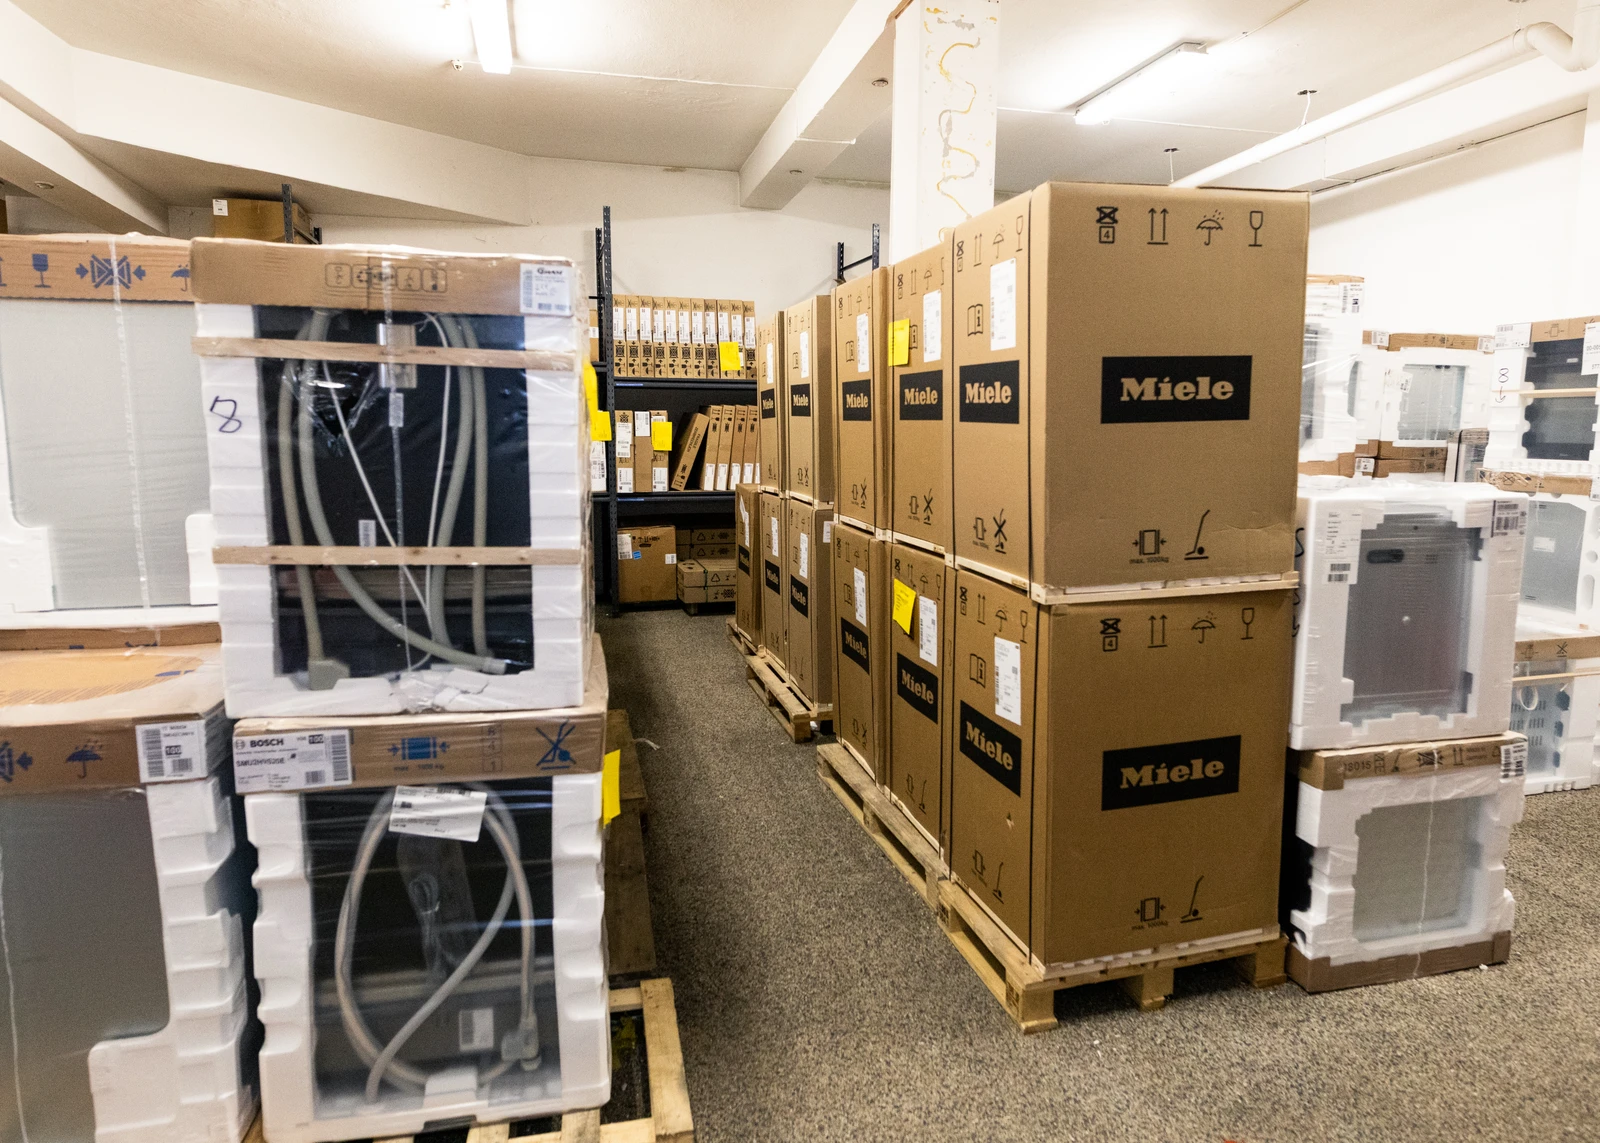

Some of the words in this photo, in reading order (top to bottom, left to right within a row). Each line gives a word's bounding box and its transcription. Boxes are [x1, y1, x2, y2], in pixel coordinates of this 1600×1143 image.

[1498, 367, 1510, 384] 8
[792, 394, 809, 407] Miele
[846, 392, 869, 409] Miele
[904, 387, 938, 406] Miele
[966, 381, 1012, 404] Miele
[1121, 376, 1234, 402] Miele
[791, 584, 807, 607] Miele
[844, 630, 868, 661] Miele
[901, 668, 935, 706] Miele
[249, 738, 285, 748] BOSCH
[965, 719, 1015, 773] Miele
[1120, 758, 1225, 790] Miele
